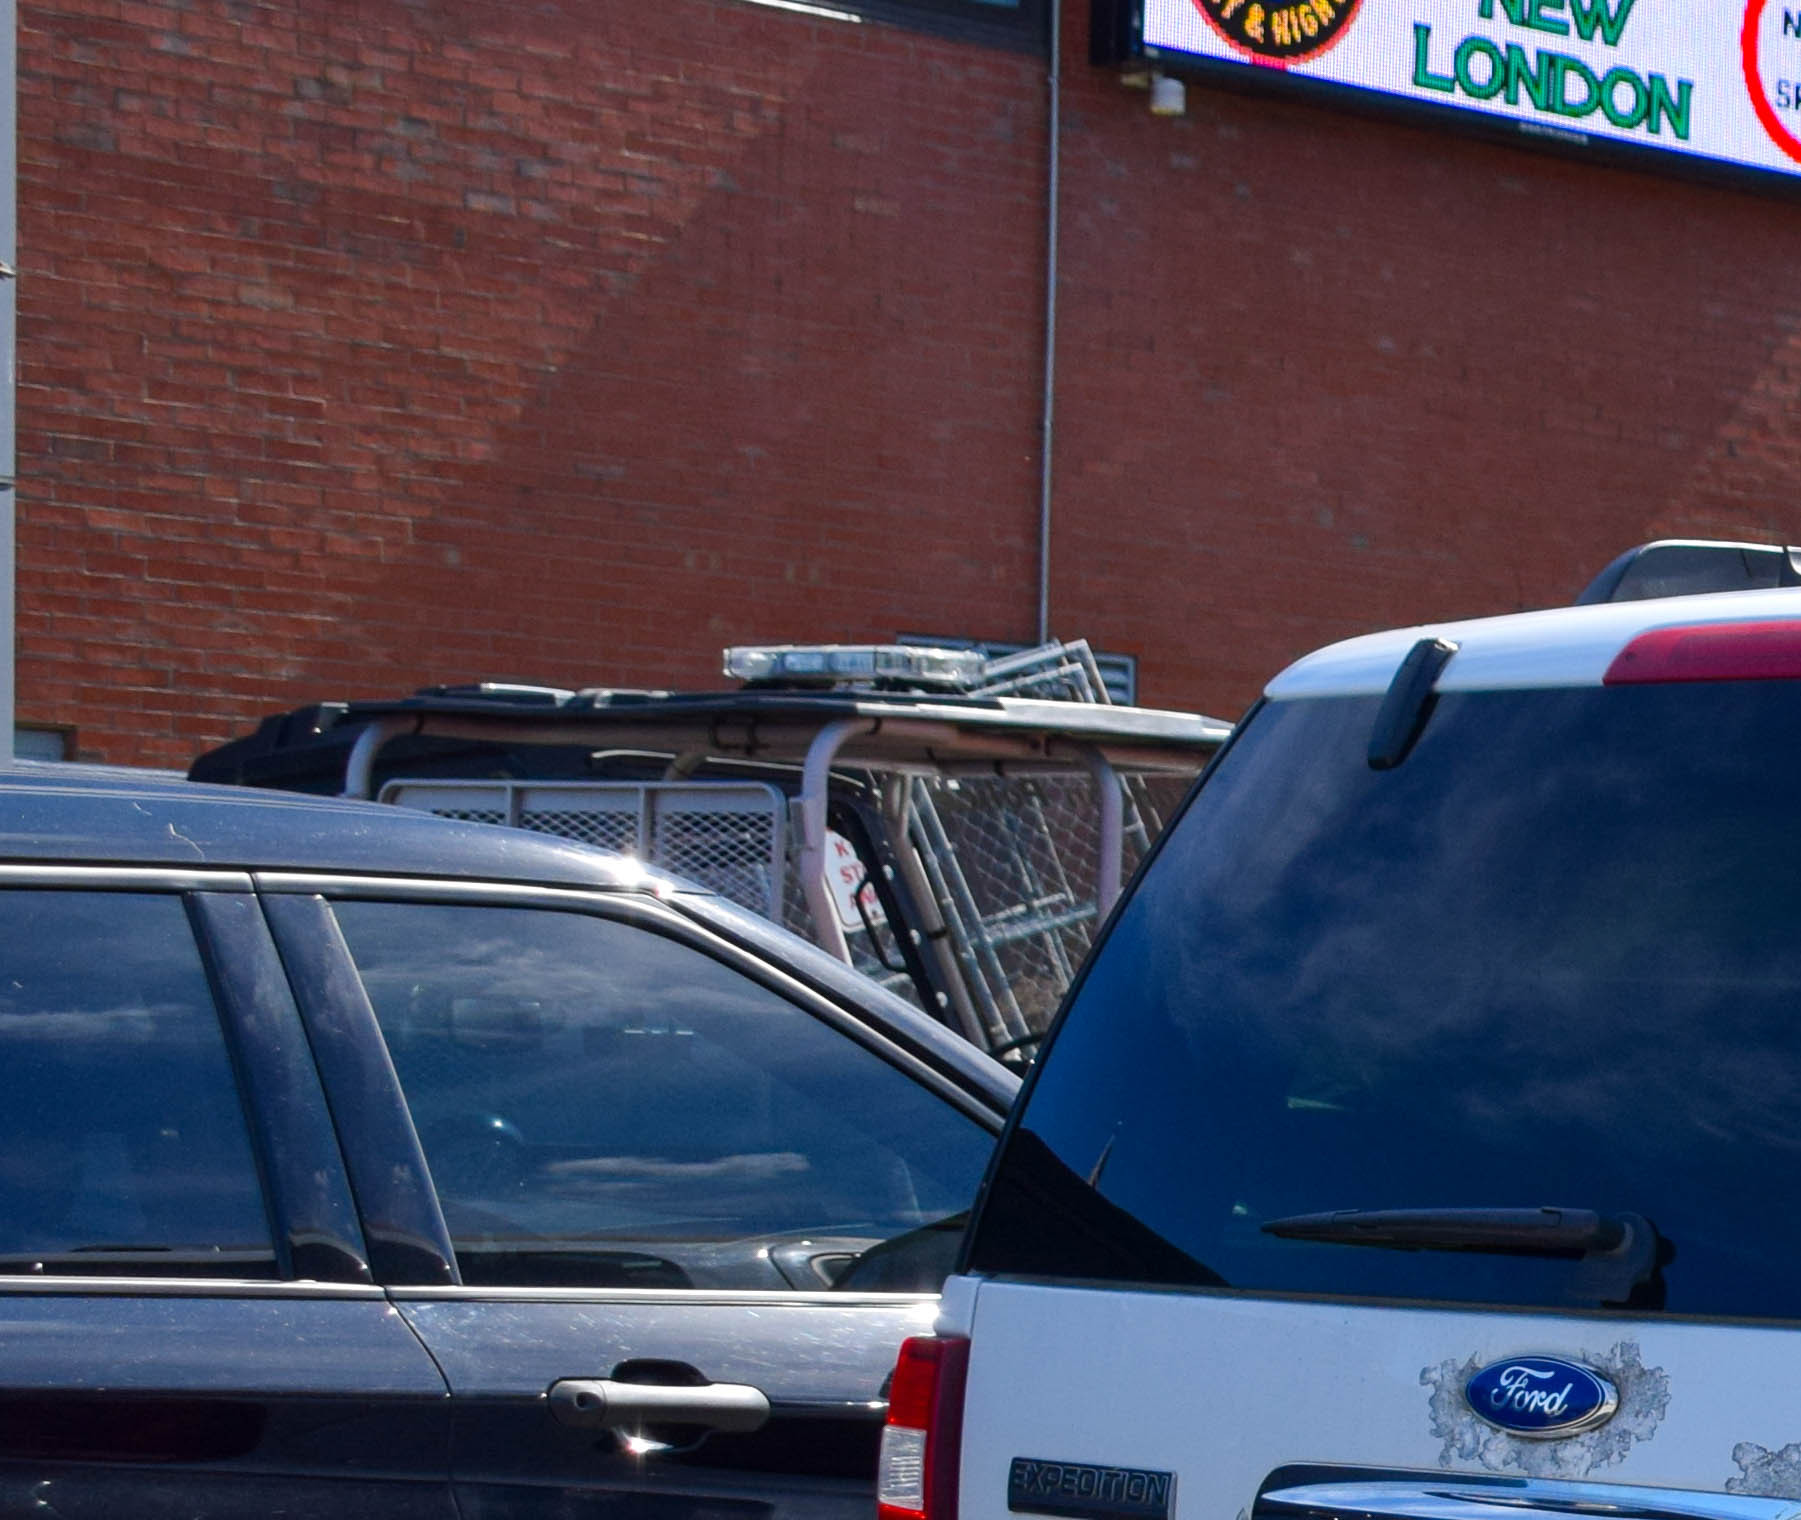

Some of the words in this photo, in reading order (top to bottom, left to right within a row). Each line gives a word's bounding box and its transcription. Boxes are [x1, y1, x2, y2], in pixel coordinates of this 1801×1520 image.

[1413, 20, 1693, 140] LONDON
[1491, 1366, 1573, 1417] Ford
[1013, 1460, 1170, 1504] EXPEDITION
